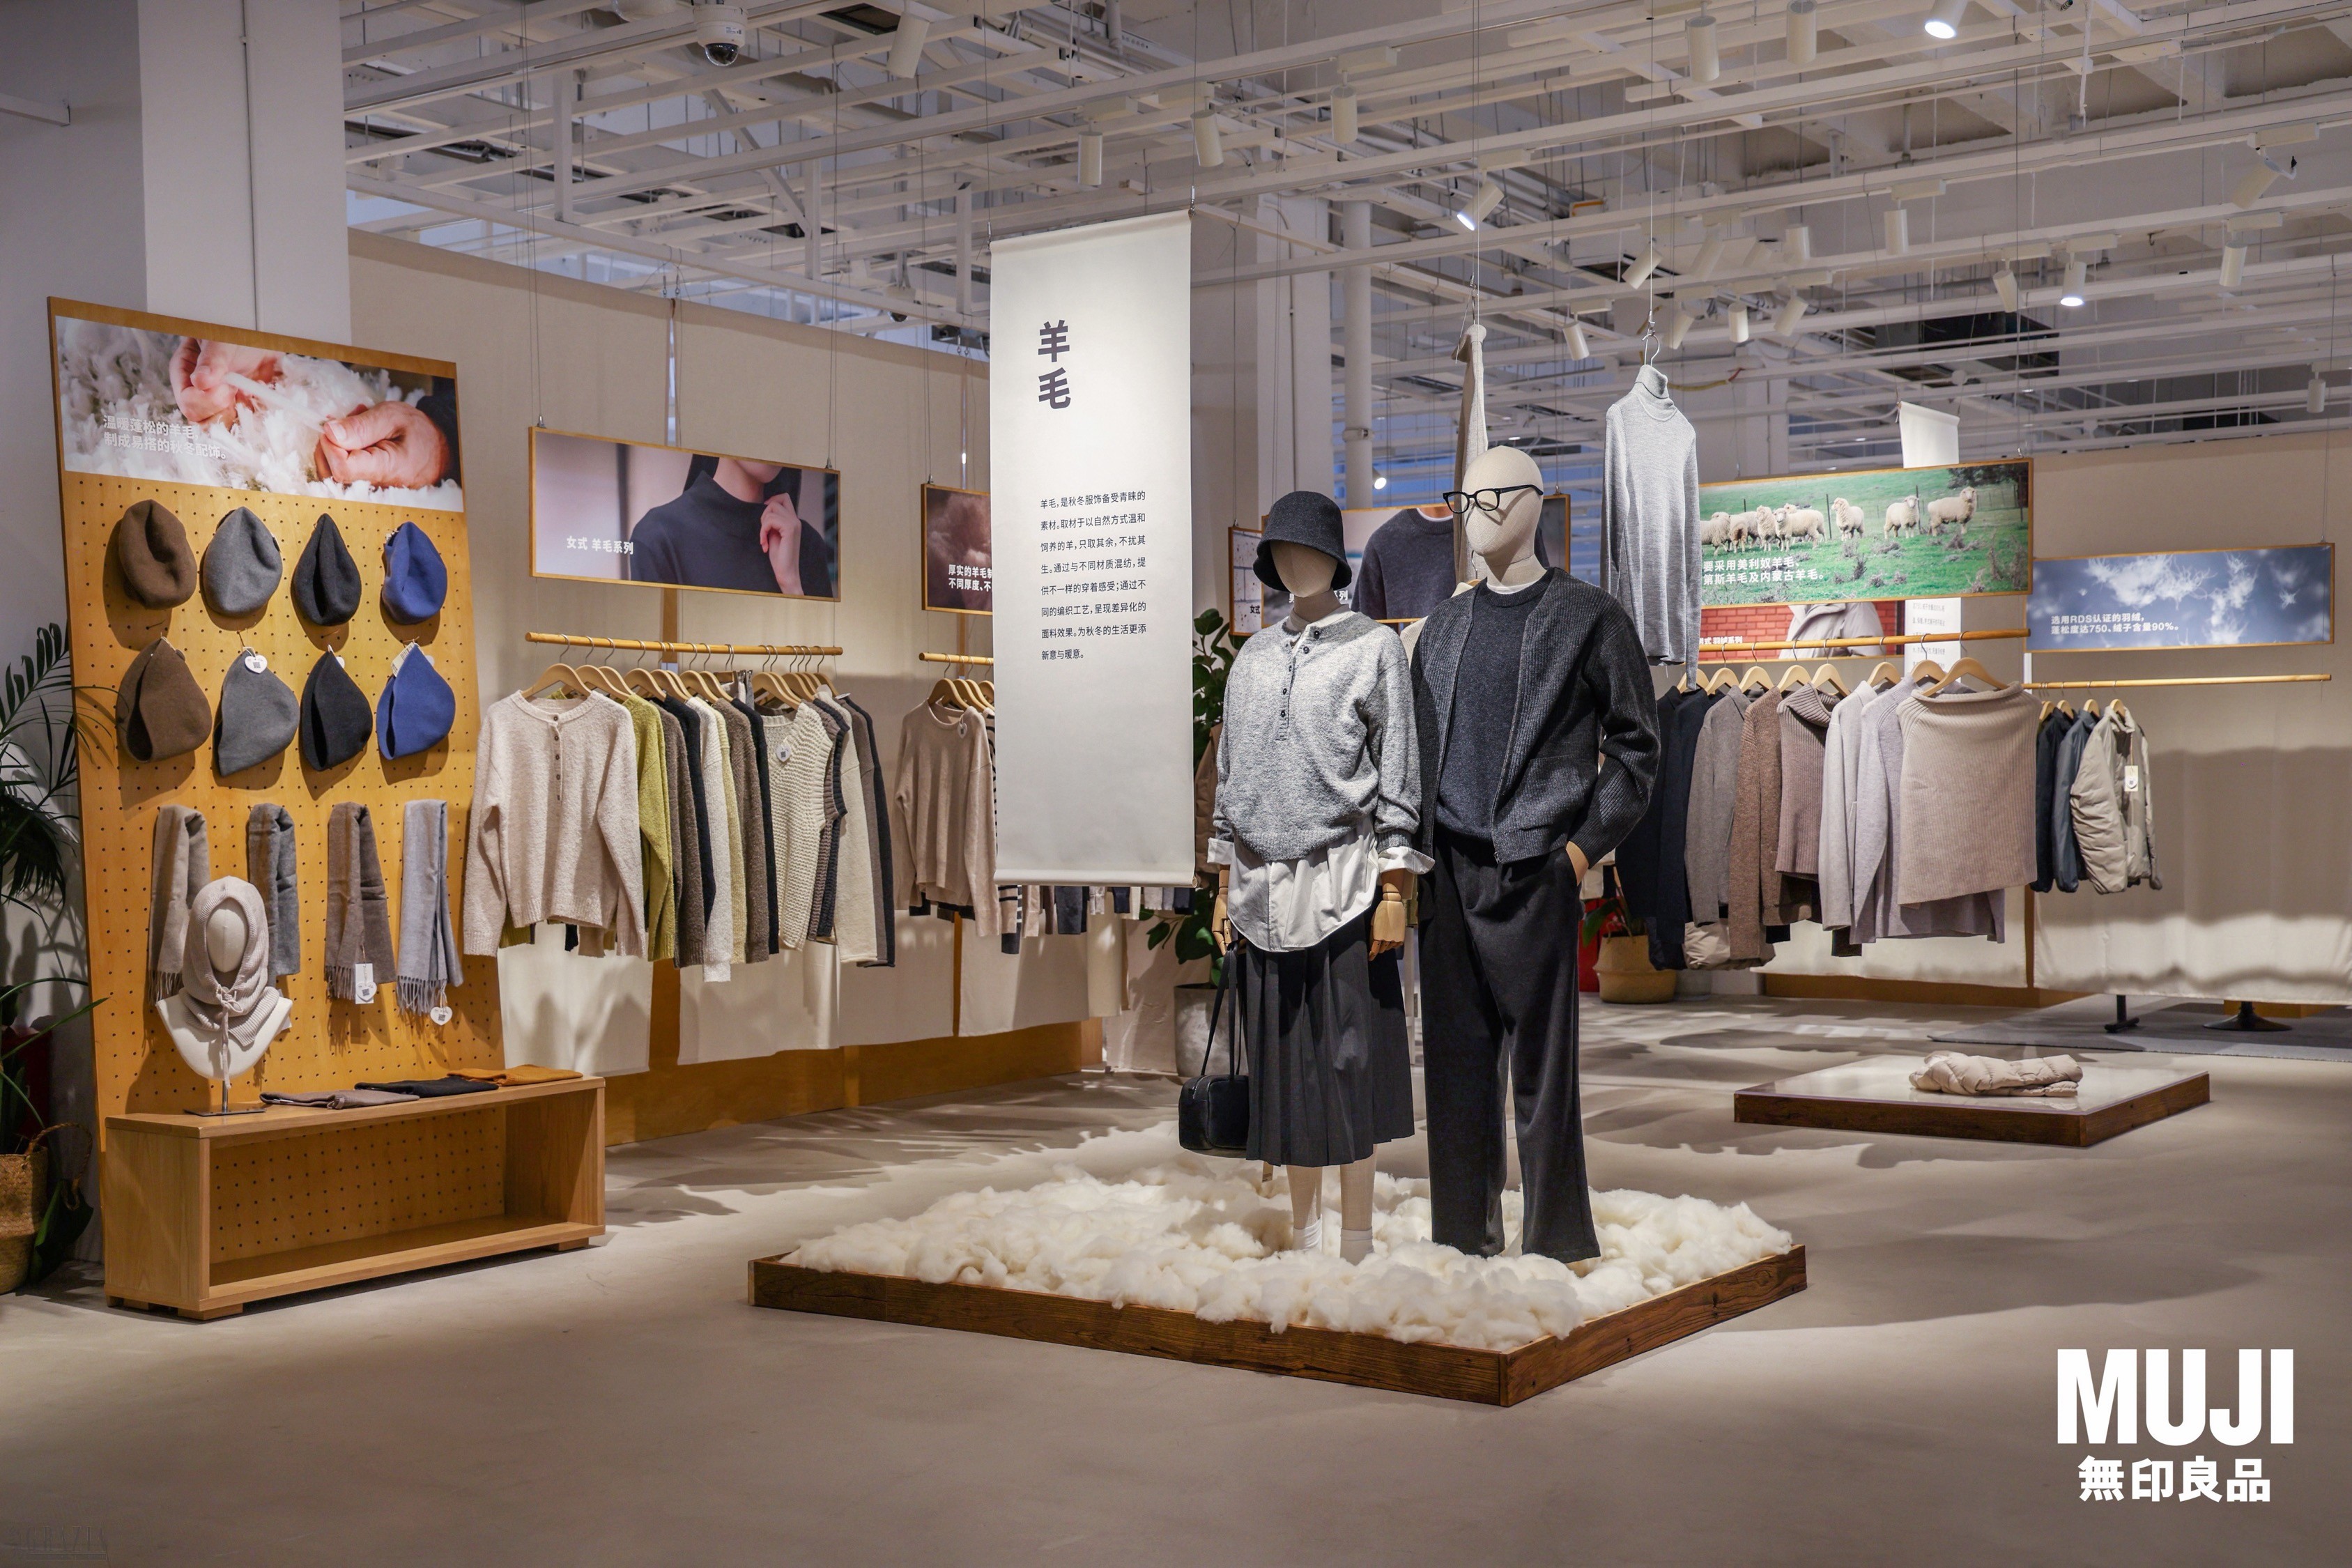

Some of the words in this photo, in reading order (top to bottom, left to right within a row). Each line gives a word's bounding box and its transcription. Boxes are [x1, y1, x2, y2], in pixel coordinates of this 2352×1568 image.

[1038, 319, 1071, 410] 羊毛
[1040, 512, 1146, 531] 素材。取材于以自然方式温和
[567, 535, 588, 551] 女式
[592, 538, 634, 555] 羊毛系列
[1041, 624, 1147, 639] 面料效果。为秋冬的生活更添
[1041, 649, 1084, 661] 新意与暖意。
